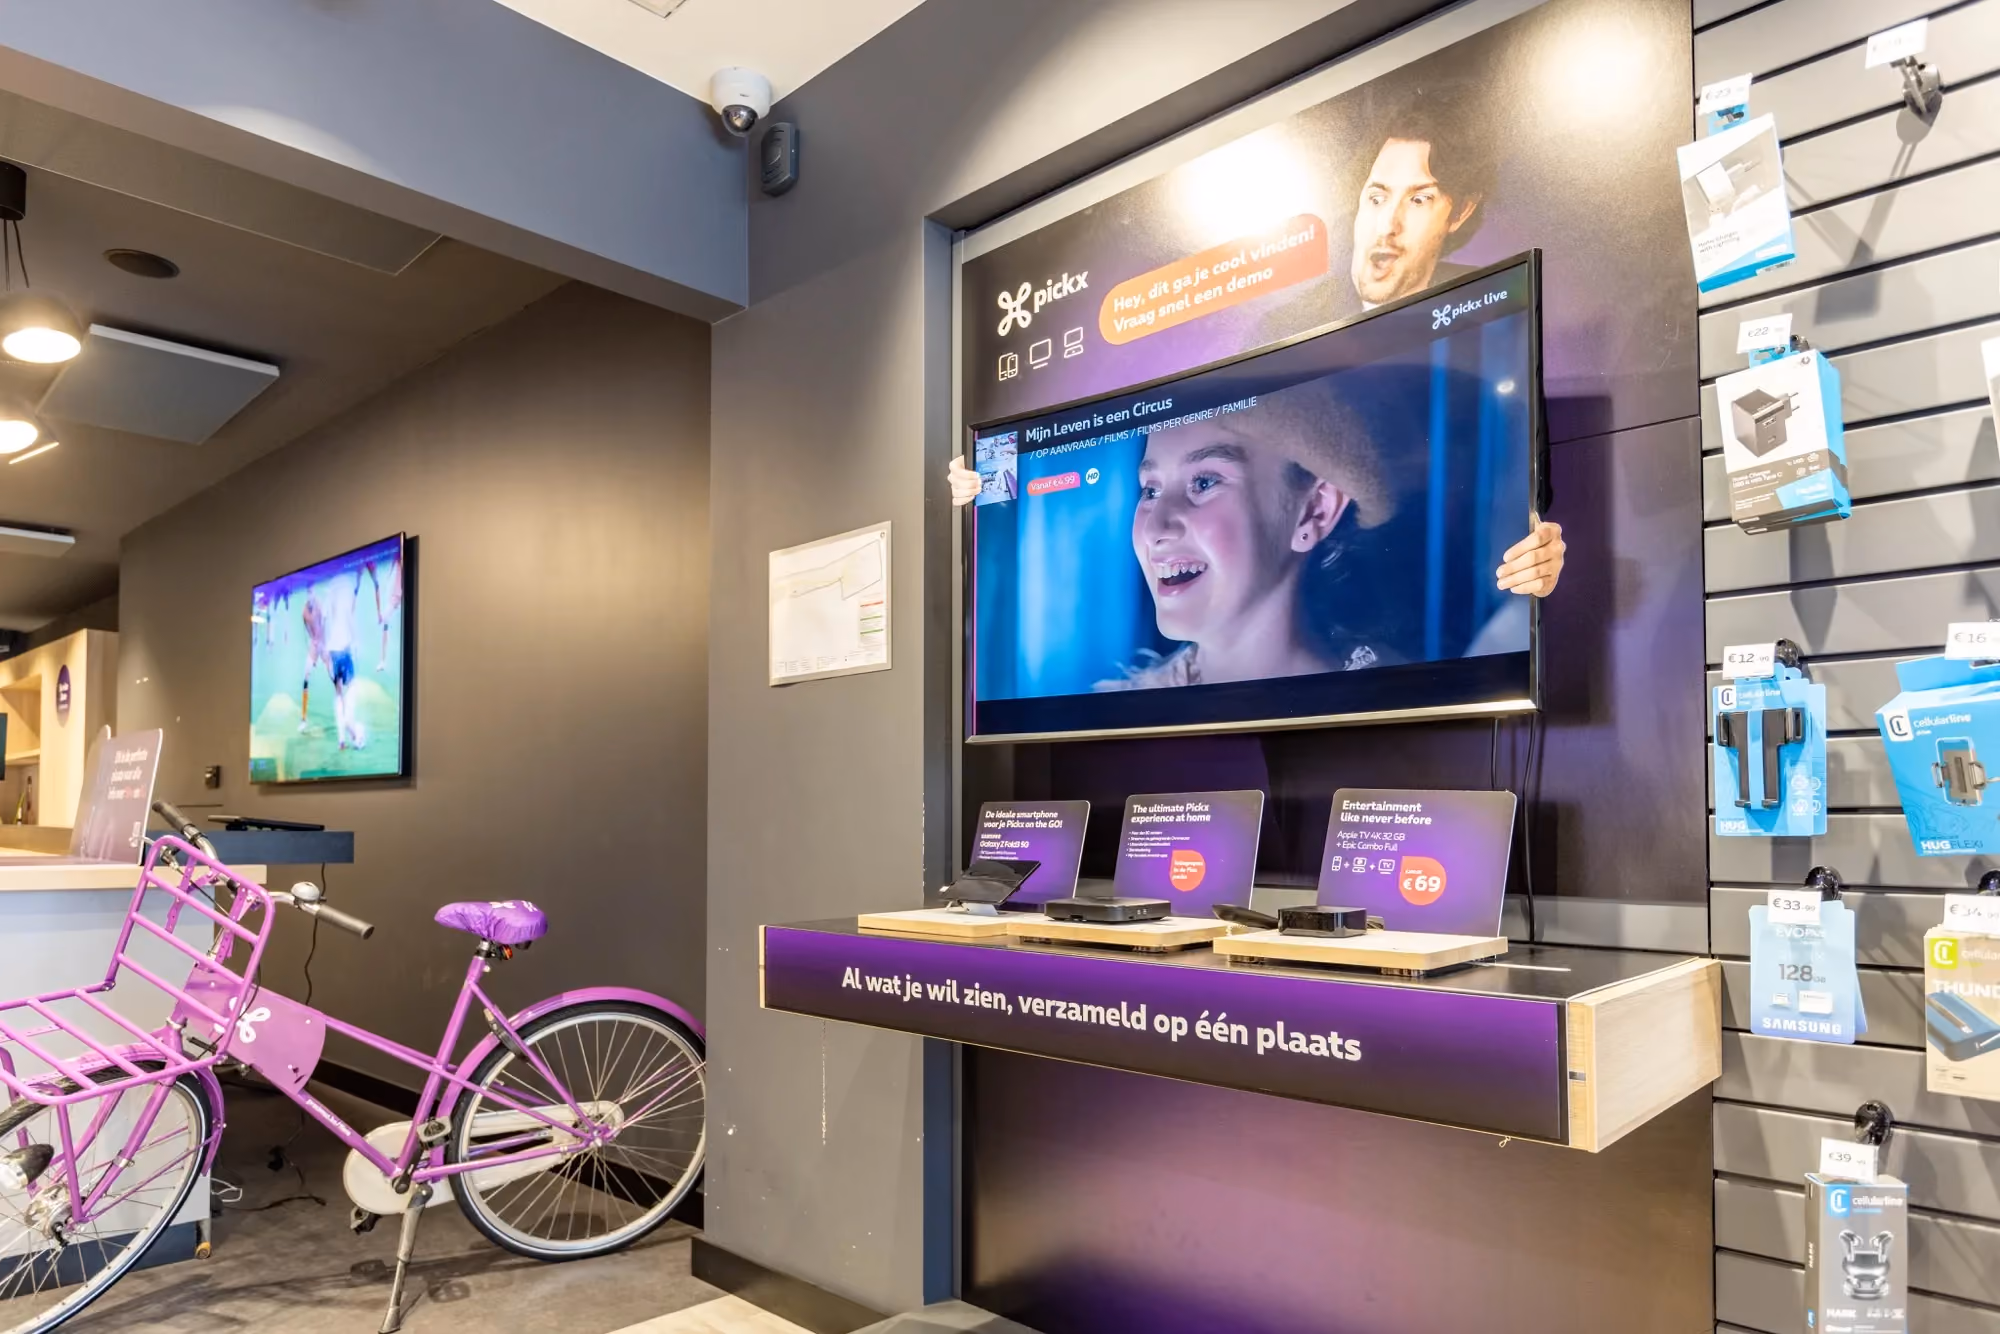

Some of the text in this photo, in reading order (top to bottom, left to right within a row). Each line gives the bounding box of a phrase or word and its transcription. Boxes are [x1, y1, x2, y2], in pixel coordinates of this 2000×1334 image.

[1113, 224, 1315, 313] Hey, dit ga je cool vinden!
[1033, 271, 1089, 313] pickx
[1113, 267, 1274, 333] Vraag snel een demo
[1452, 290, 1508, 319] pickx live
[1025, 398, 1173, 442] Mijn Leven is een Circus
[1035, 447, 1049, 460] OP
[1049, 438, 1097, 456] AANVRAAG
[1104, 430, 1129, 445] FILMS
[1137, 422, 1162, 437] FILMS
[1163, 418, 1182, 431] PER
[1182, 409, 1214, 425] GENRE
[1222, 396, 1257, 415] FAMILIE
[1087, 472, 1099, 481] HD
[1913, 713, 1972, 729] cellularline
[1133, 802, 1210, 814] The ultimate Pickx
[1342, 800, 1422, 812] Entertainment
[985, 810, 1059, 820] De ideale smartphone
[1131, 812, 1212, 825] experience at home
[1340, 812, 1432, 825] like never before
[1006, 819, 1025, 828] Pickx
[1035, 820, 1048, 828] the
[1048, 820, 1063, 829] GO!
[1337, 830, 1406, 841] Apple TV 4K 32 GB
[979, 841, 1000, 850] Galaxy
[1005, 841, 1021, 849] Fold3
[1020, 841, 1030, 849] 5G
[1342, 841, 1357, 850] Epic
[1357, 841, 1384, 851] Combo
[1384, 842, 1398, 851] Full
[841, 967, 1362, 1062] Al wat je wil zien, verzameld op één plaats
[1762, 1017, 1842, 1035] SAMSUNG
[1852, 1195, 1904, 1207] cellularline
